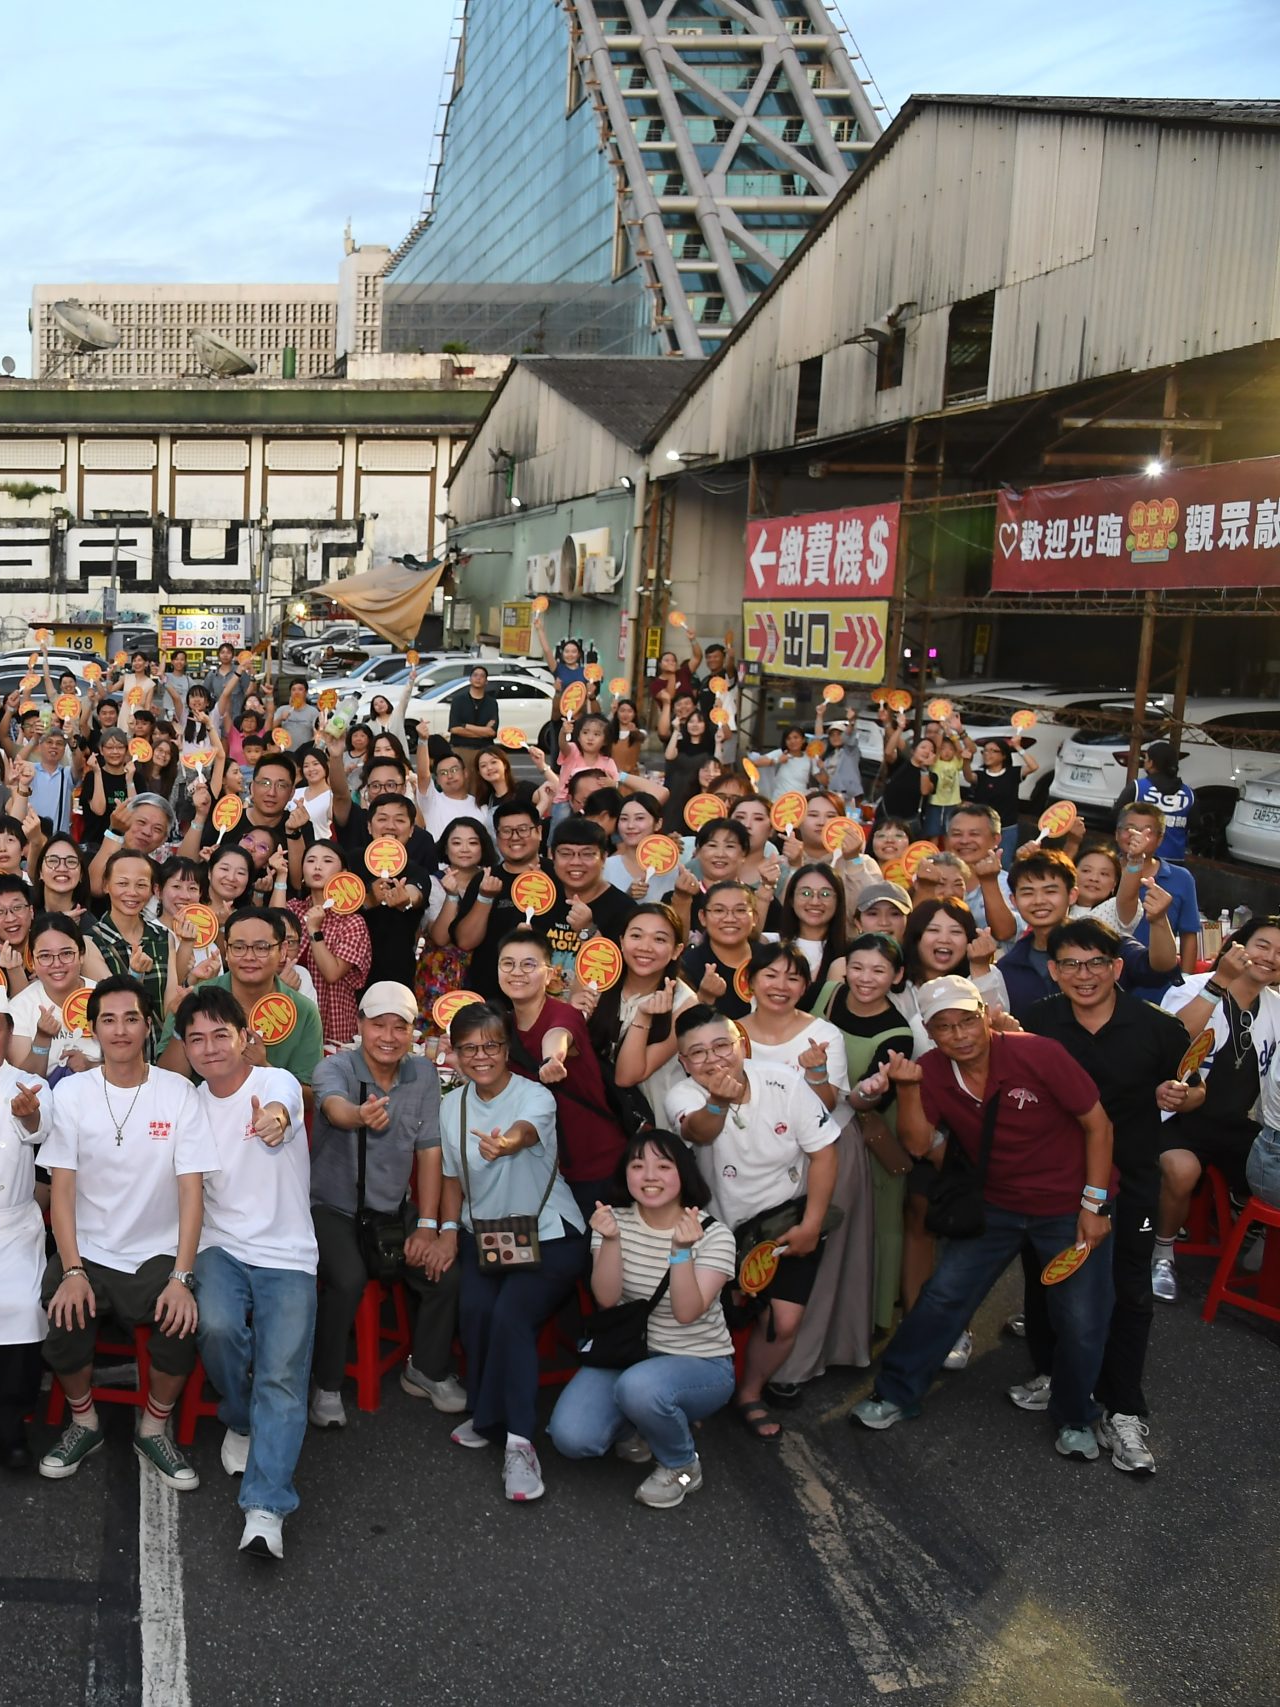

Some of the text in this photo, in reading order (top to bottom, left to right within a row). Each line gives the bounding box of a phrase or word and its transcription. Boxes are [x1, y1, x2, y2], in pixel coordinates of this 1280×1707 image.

[1019, 512, 1123, 562] 歡迎光臨
[178, 621, 193, 630] 50
[200, 621, 215, 630] 20
[66, 636, 93, 650] 168
[178, 637, 193, 646] 70
[200, 637, 215, 646] 20
[783, 610, 831, 669] 出口
